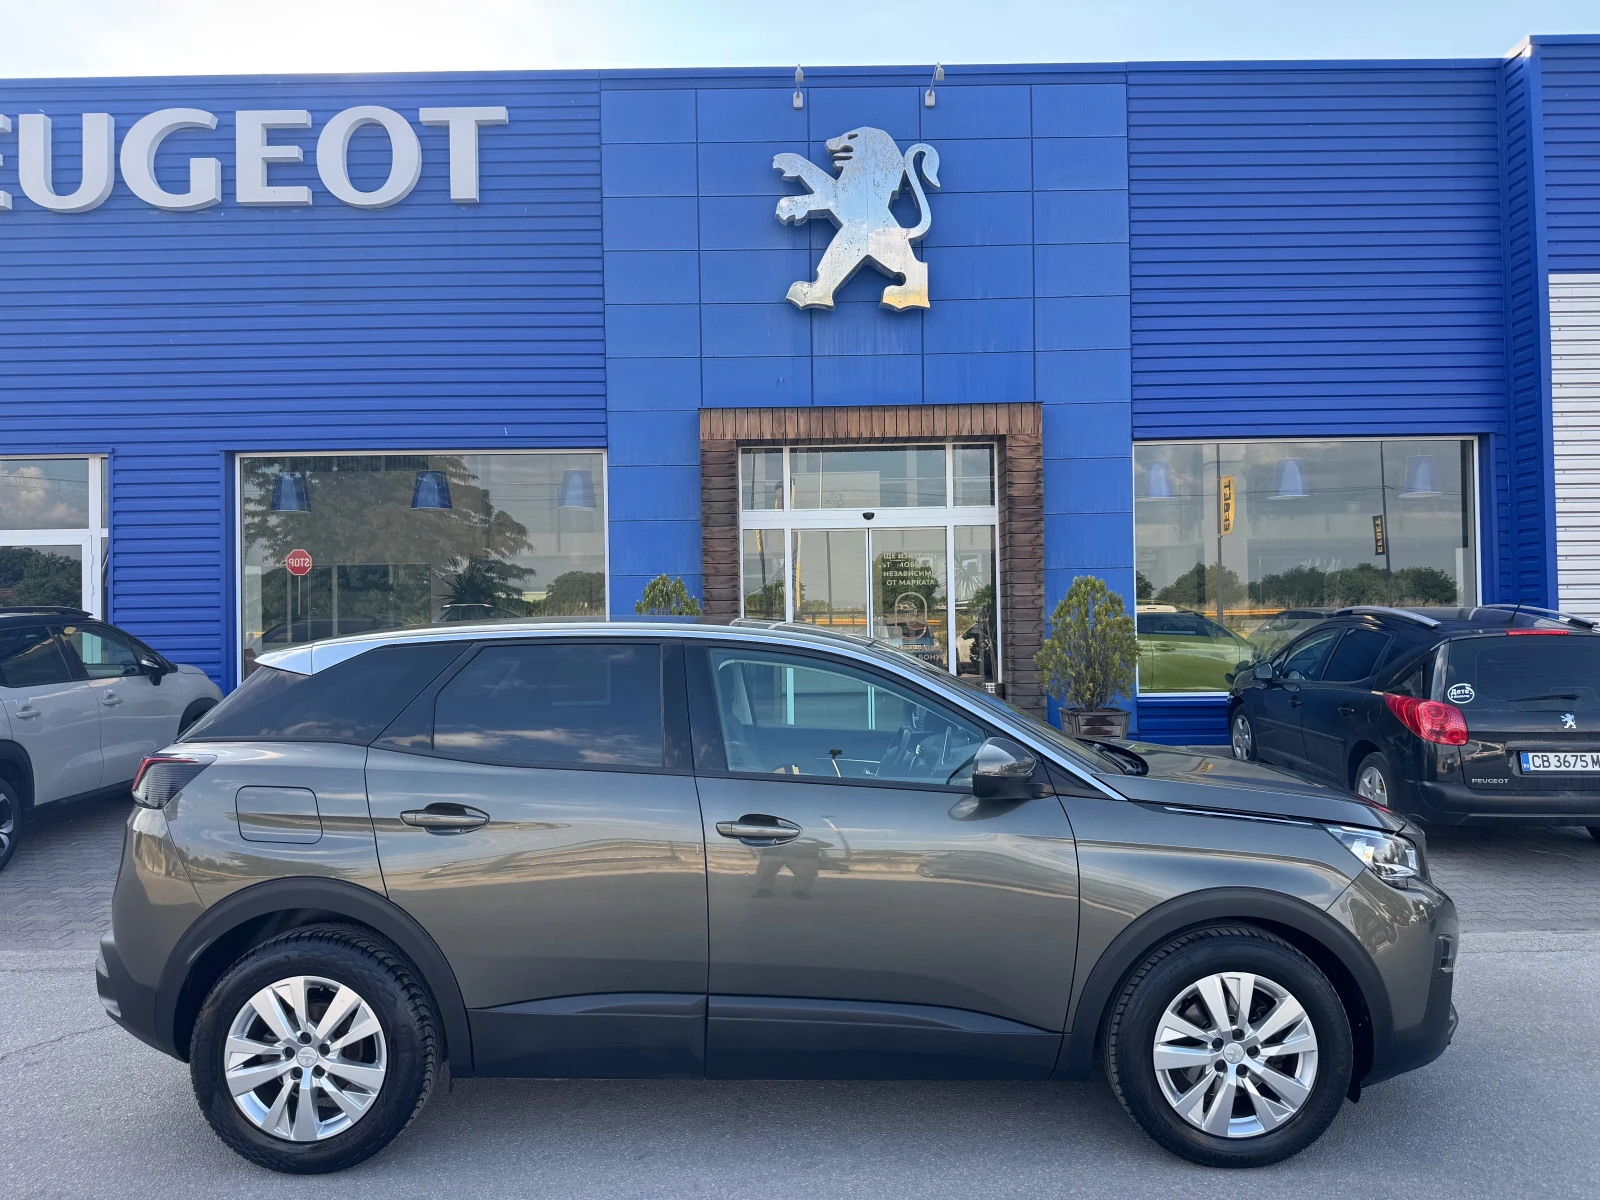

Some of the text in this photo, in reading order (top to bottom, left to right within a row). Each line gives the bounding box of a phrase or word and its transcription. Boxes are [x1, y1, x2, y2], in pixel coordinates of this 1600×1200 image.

[0, 105, 509, 213] UGEOT
[1531, 754, 1551, 768] CB
[1554, 754, 1589, 768] 3675
